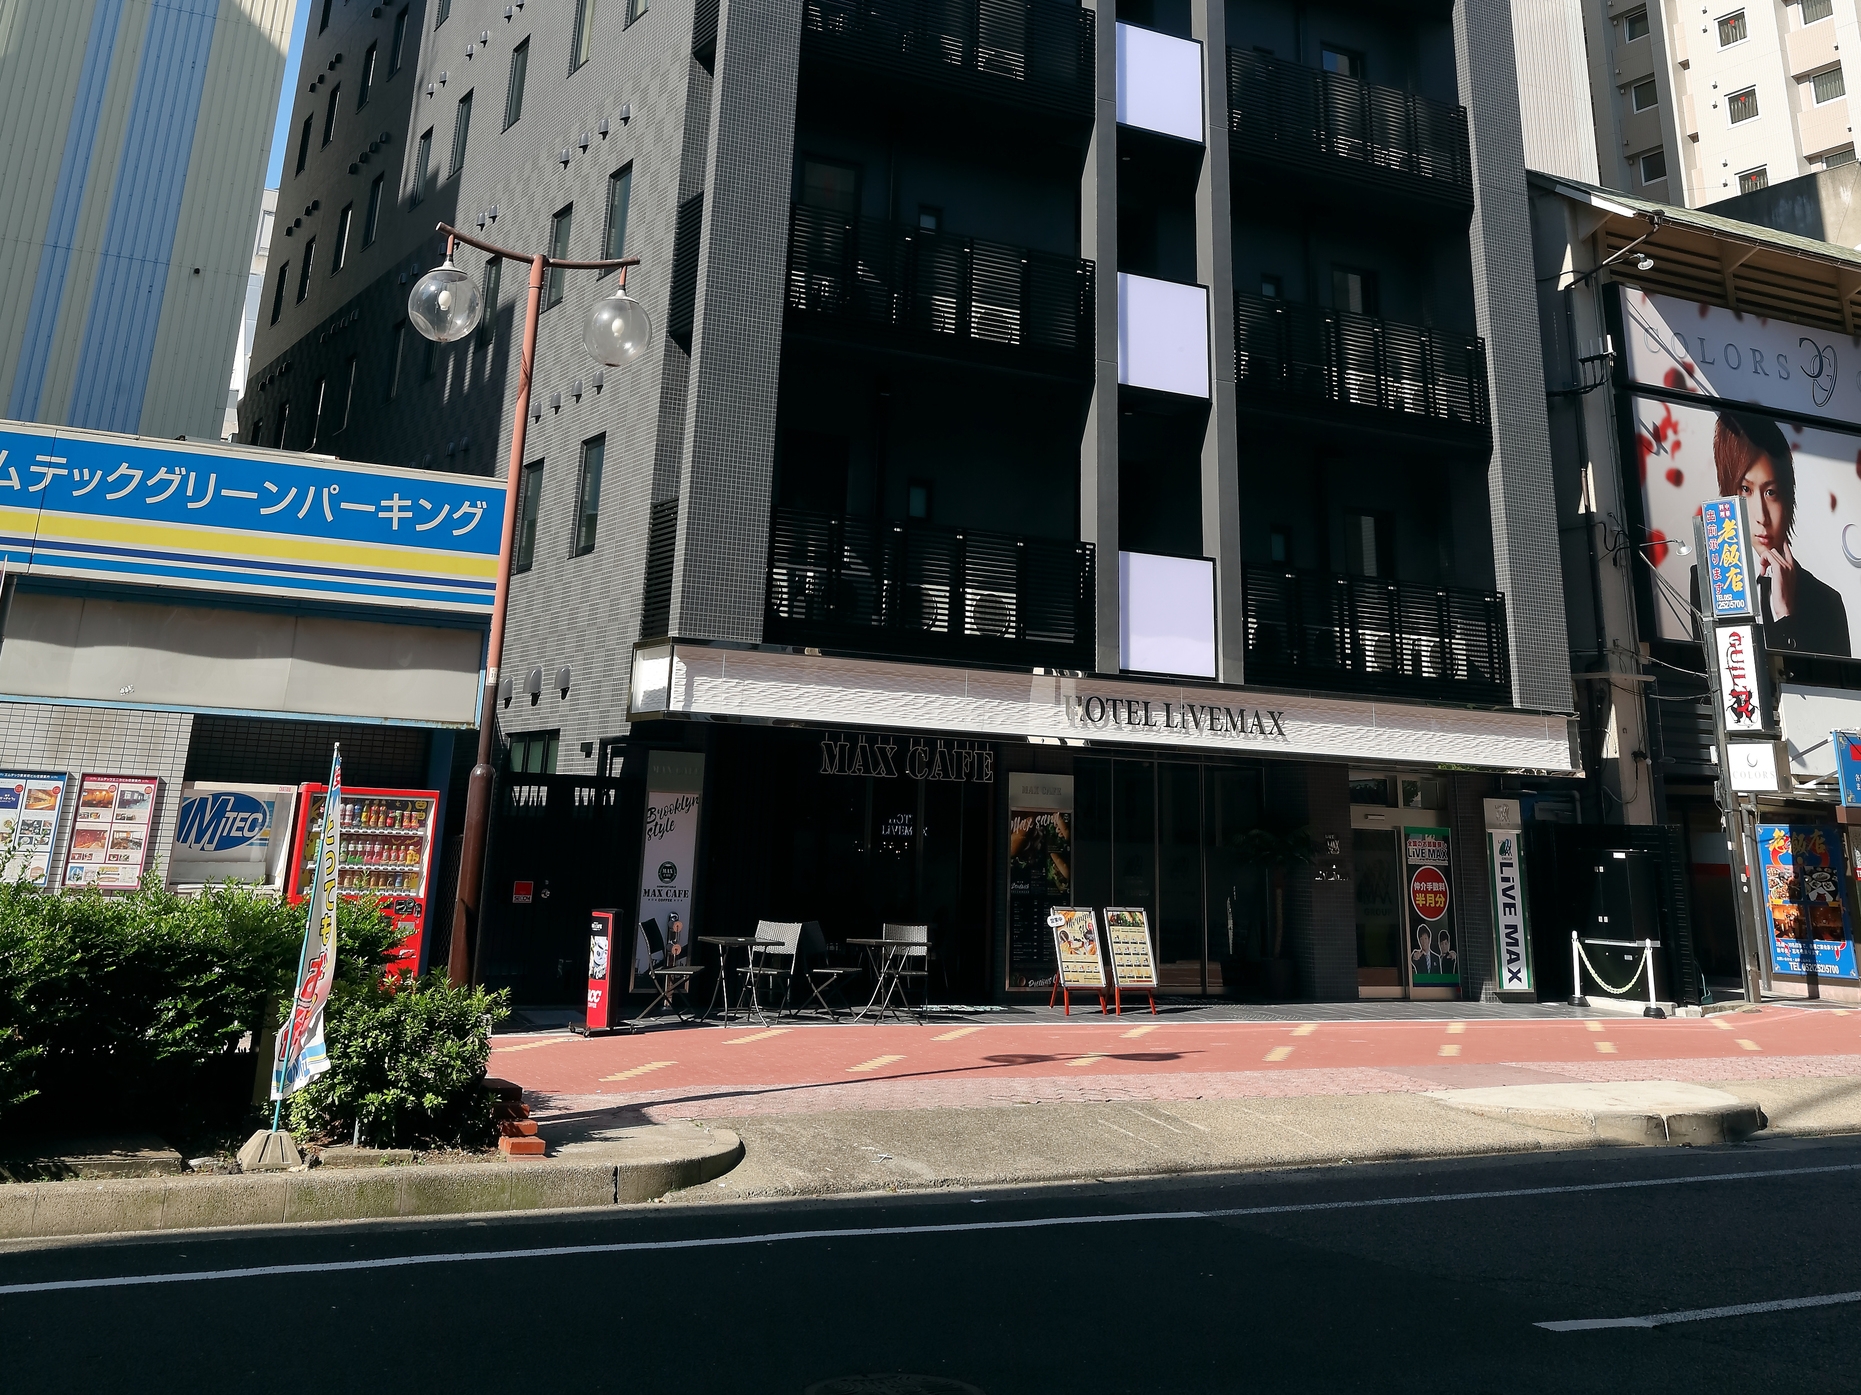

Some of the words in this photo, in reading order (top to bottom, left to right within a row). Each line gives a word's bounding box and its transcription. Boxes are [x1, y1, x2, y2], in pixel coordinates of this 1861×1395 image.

[1643, 325, 1792, 381] COLORS
[1706, 510, 1725, 595] 出前承ります
[1717, 518, 1743, 592] 老飯店
[1728, 630, 1753, 722] GUILTY
[1064, 694, 1157, 727] HOTEL
[1163, 702, 1288, 737] LiVEMAX
[820, 740, 898, 778] MAX
[906, 746, 994, 783] CAFE
[1732, 769, 1777, 781] COLORS
[646, 795, 700, 825] Brooklyn
[646, 819, 676, 841] style
[643, 889, 664, 898] MAX
[665, 889, 690, 899] CAFE
[1415, 893, 1446, 907] 半月分
[1503, 924, 1522, 985] MAX
[1789, 961, 1802, 972] TEL
